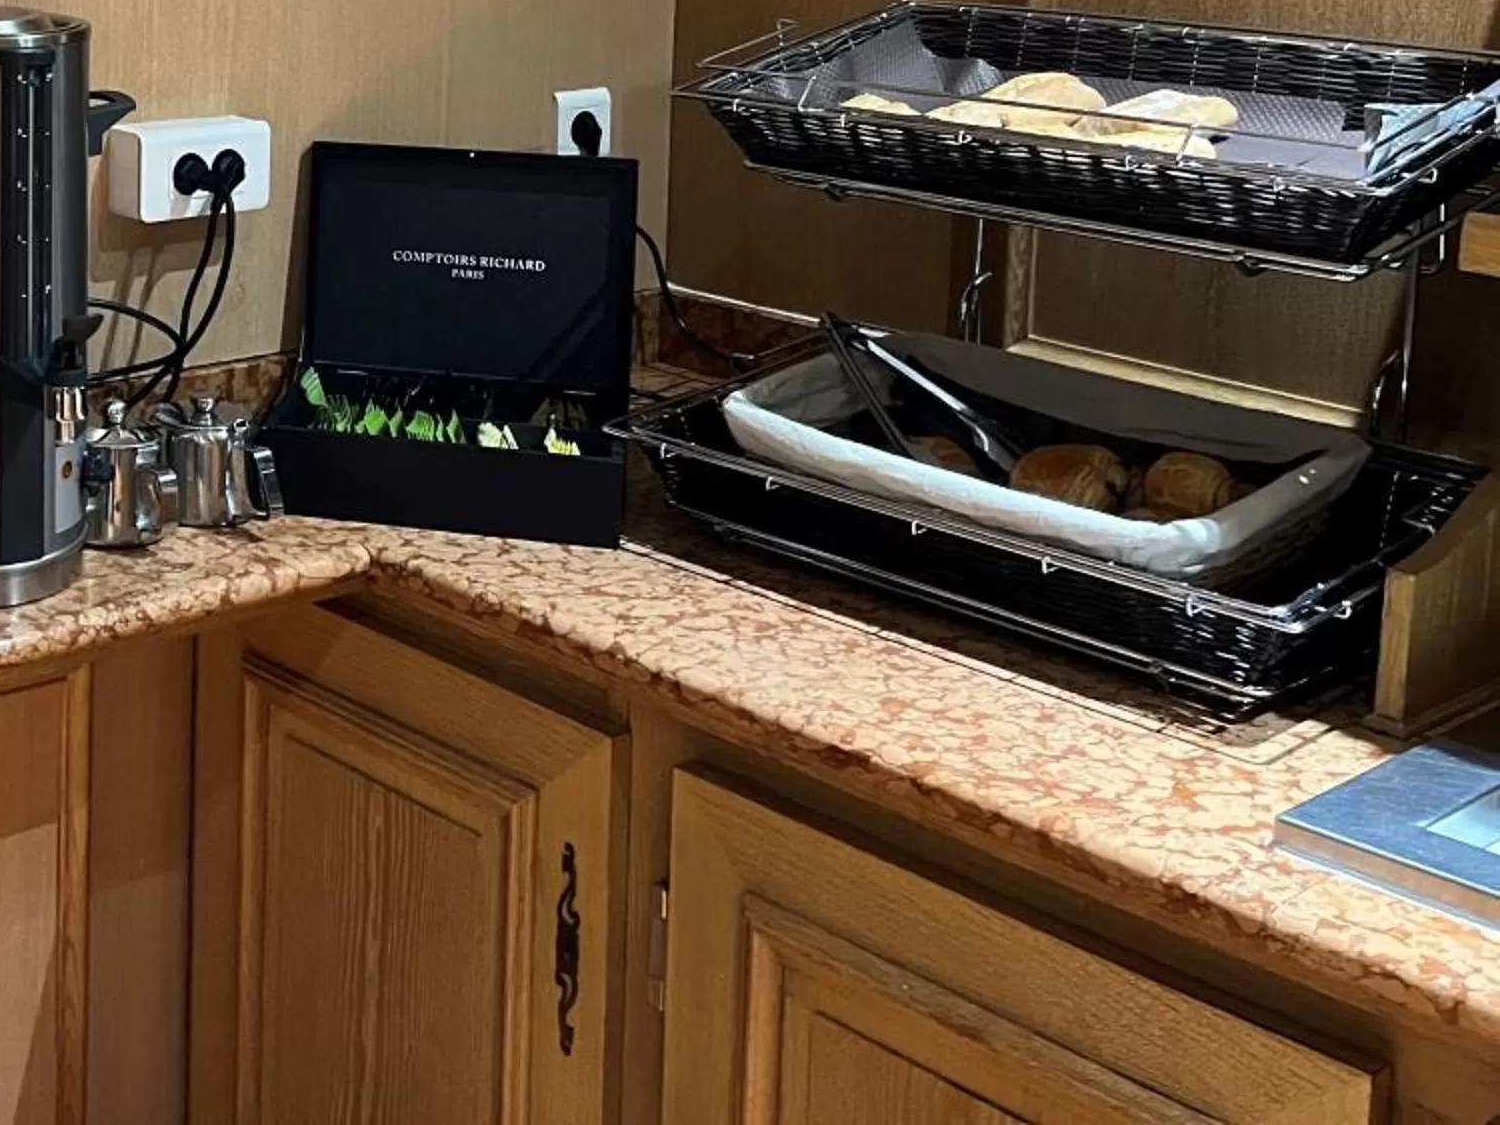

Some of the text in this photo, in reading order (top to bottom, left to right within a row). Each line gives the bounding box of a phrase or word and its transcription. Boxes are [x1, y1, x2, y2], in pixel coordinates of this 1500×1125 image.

[392, 250, 546, 272] COMPTOIRS RICHARD
[451, 268, 485, 280] PARIS
